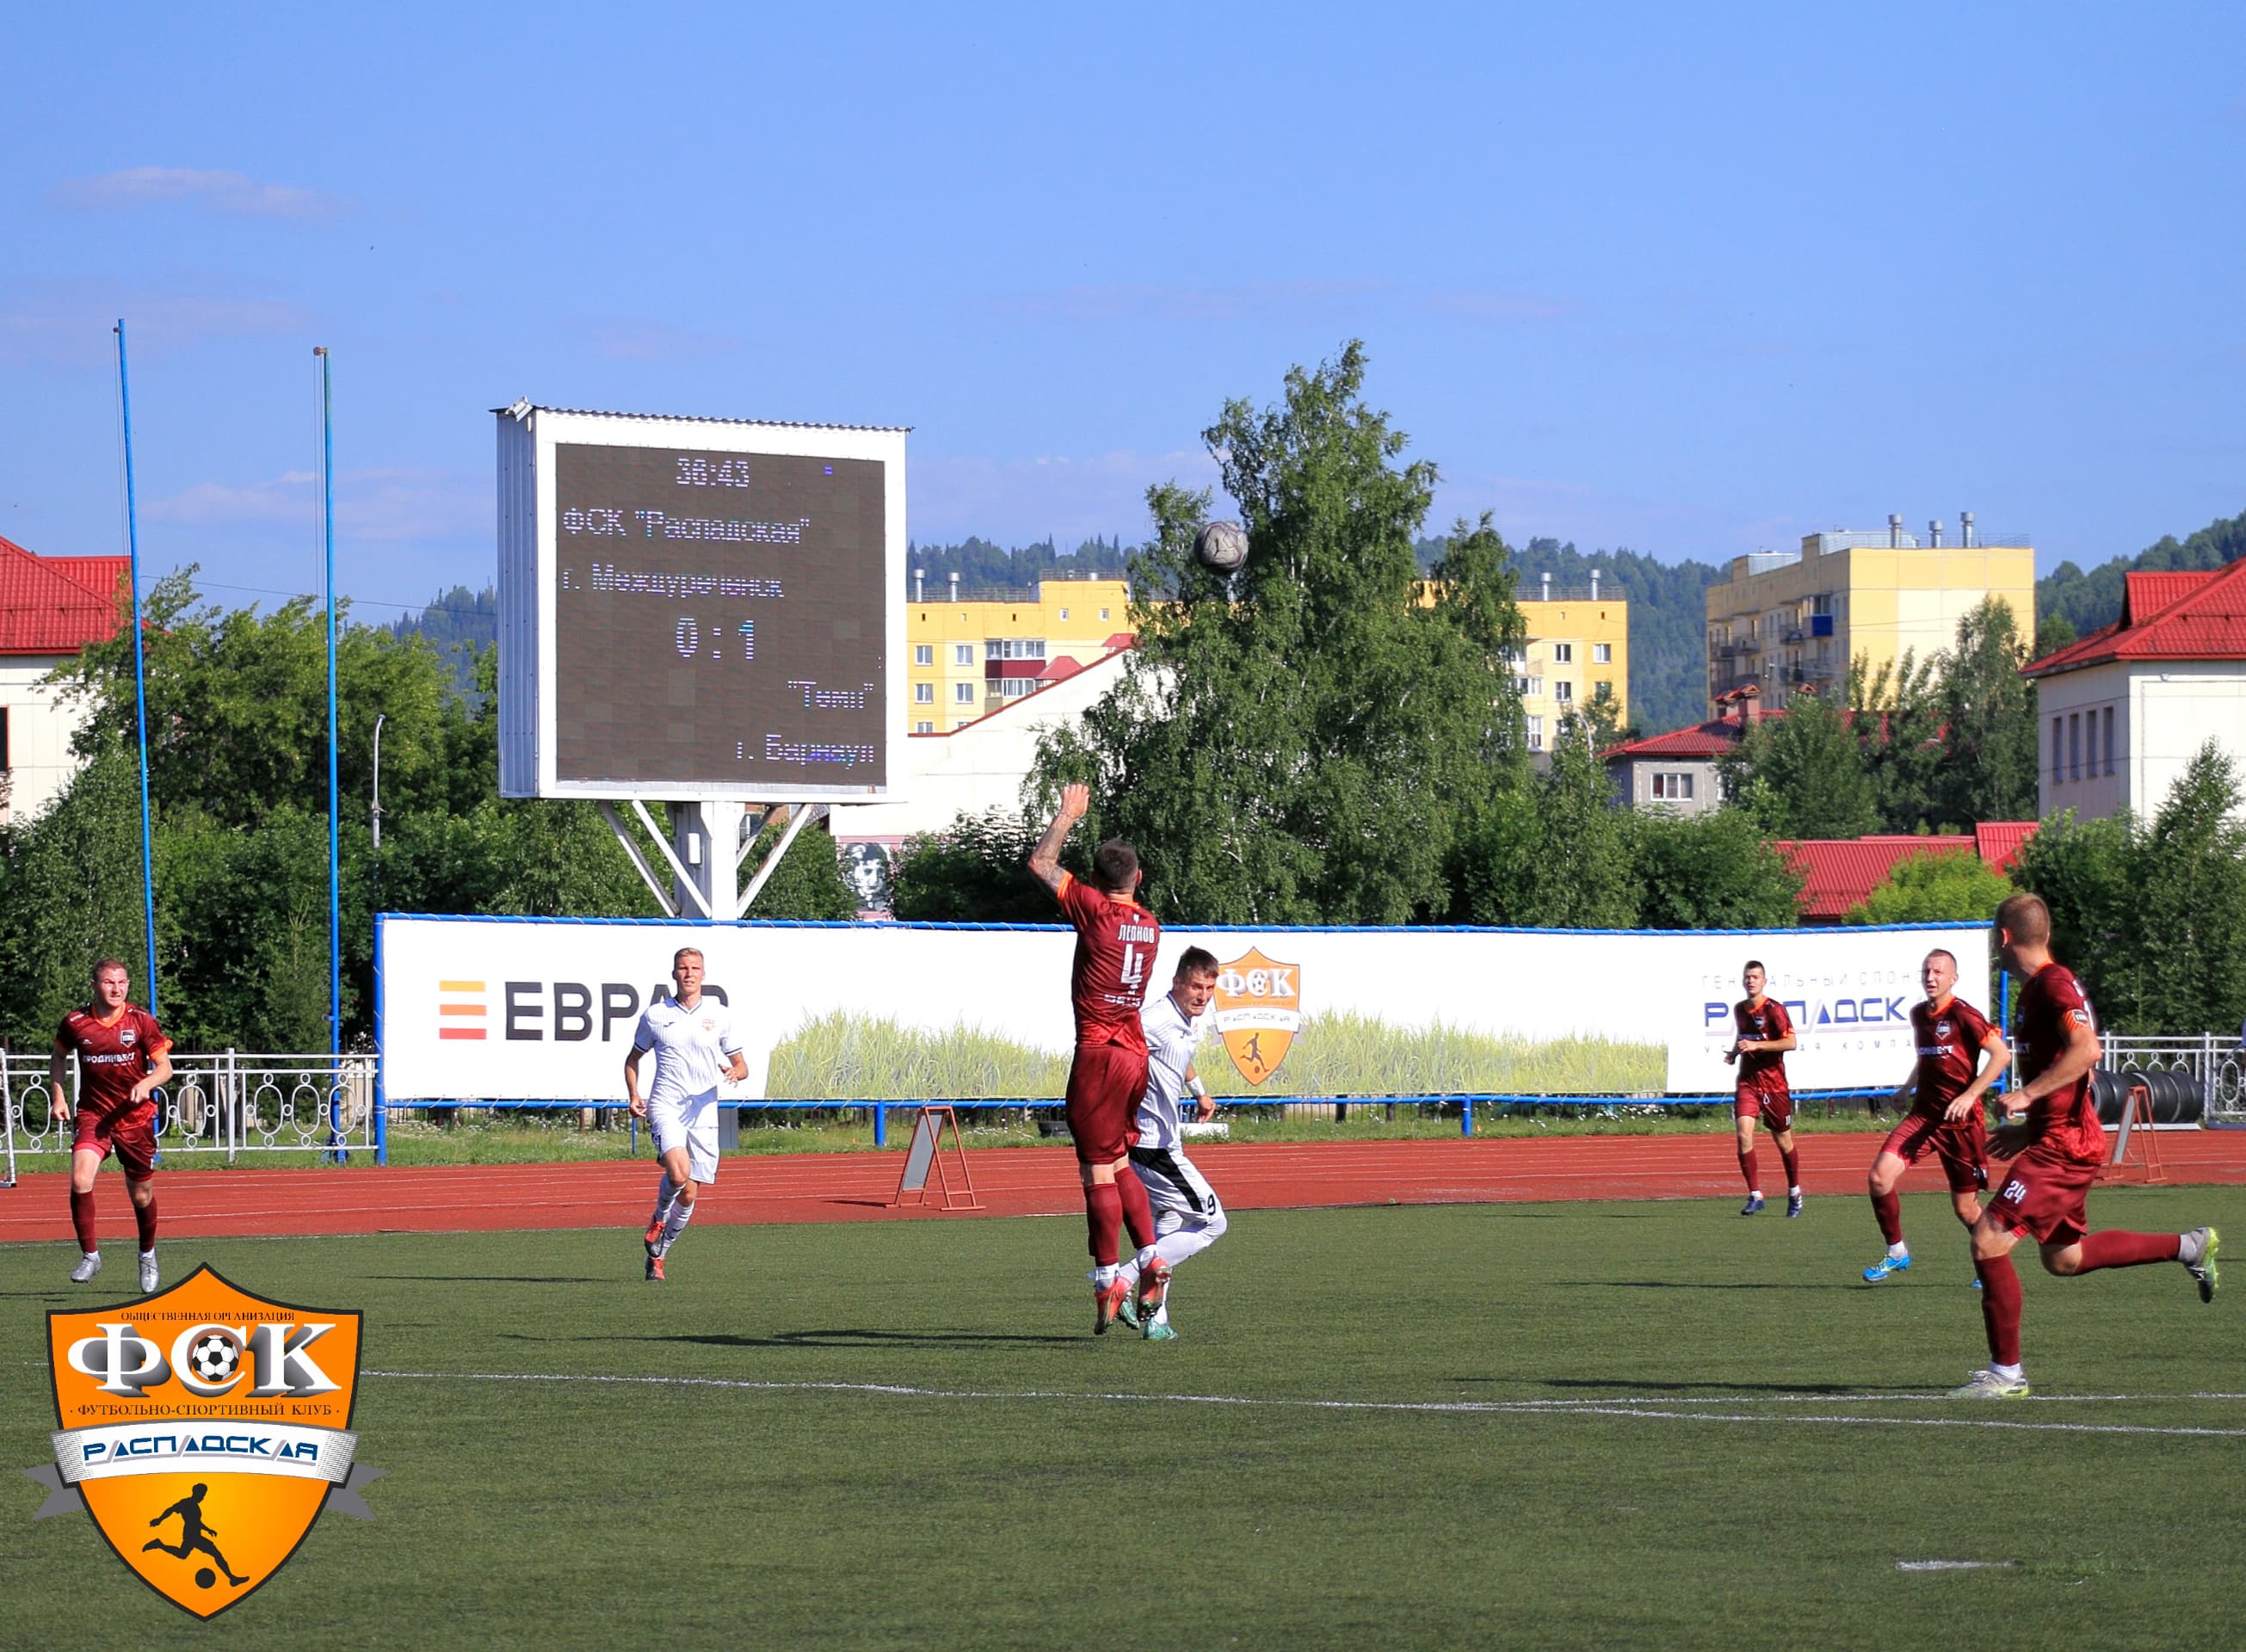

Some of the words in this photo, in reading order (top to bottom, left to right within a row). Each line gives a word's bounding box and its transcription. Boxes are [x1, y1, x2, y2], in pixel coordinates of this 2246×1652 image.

[564, 508, 626, 536] ФСК
[1118, 924, 1155, 944] ЛЕОНОВ
[1120, 943, 1144, 983] 4
[1215, 968, 1296, 998] ФСК
[1702, 972, 1848, 989] ГЕНАЛЬНЫЙ
[1705, 996, 1907, 1027] РПАДСК
[1207, 1193, 1216, 1216] 9
[2002, 1180, 2027, 1205] 24
